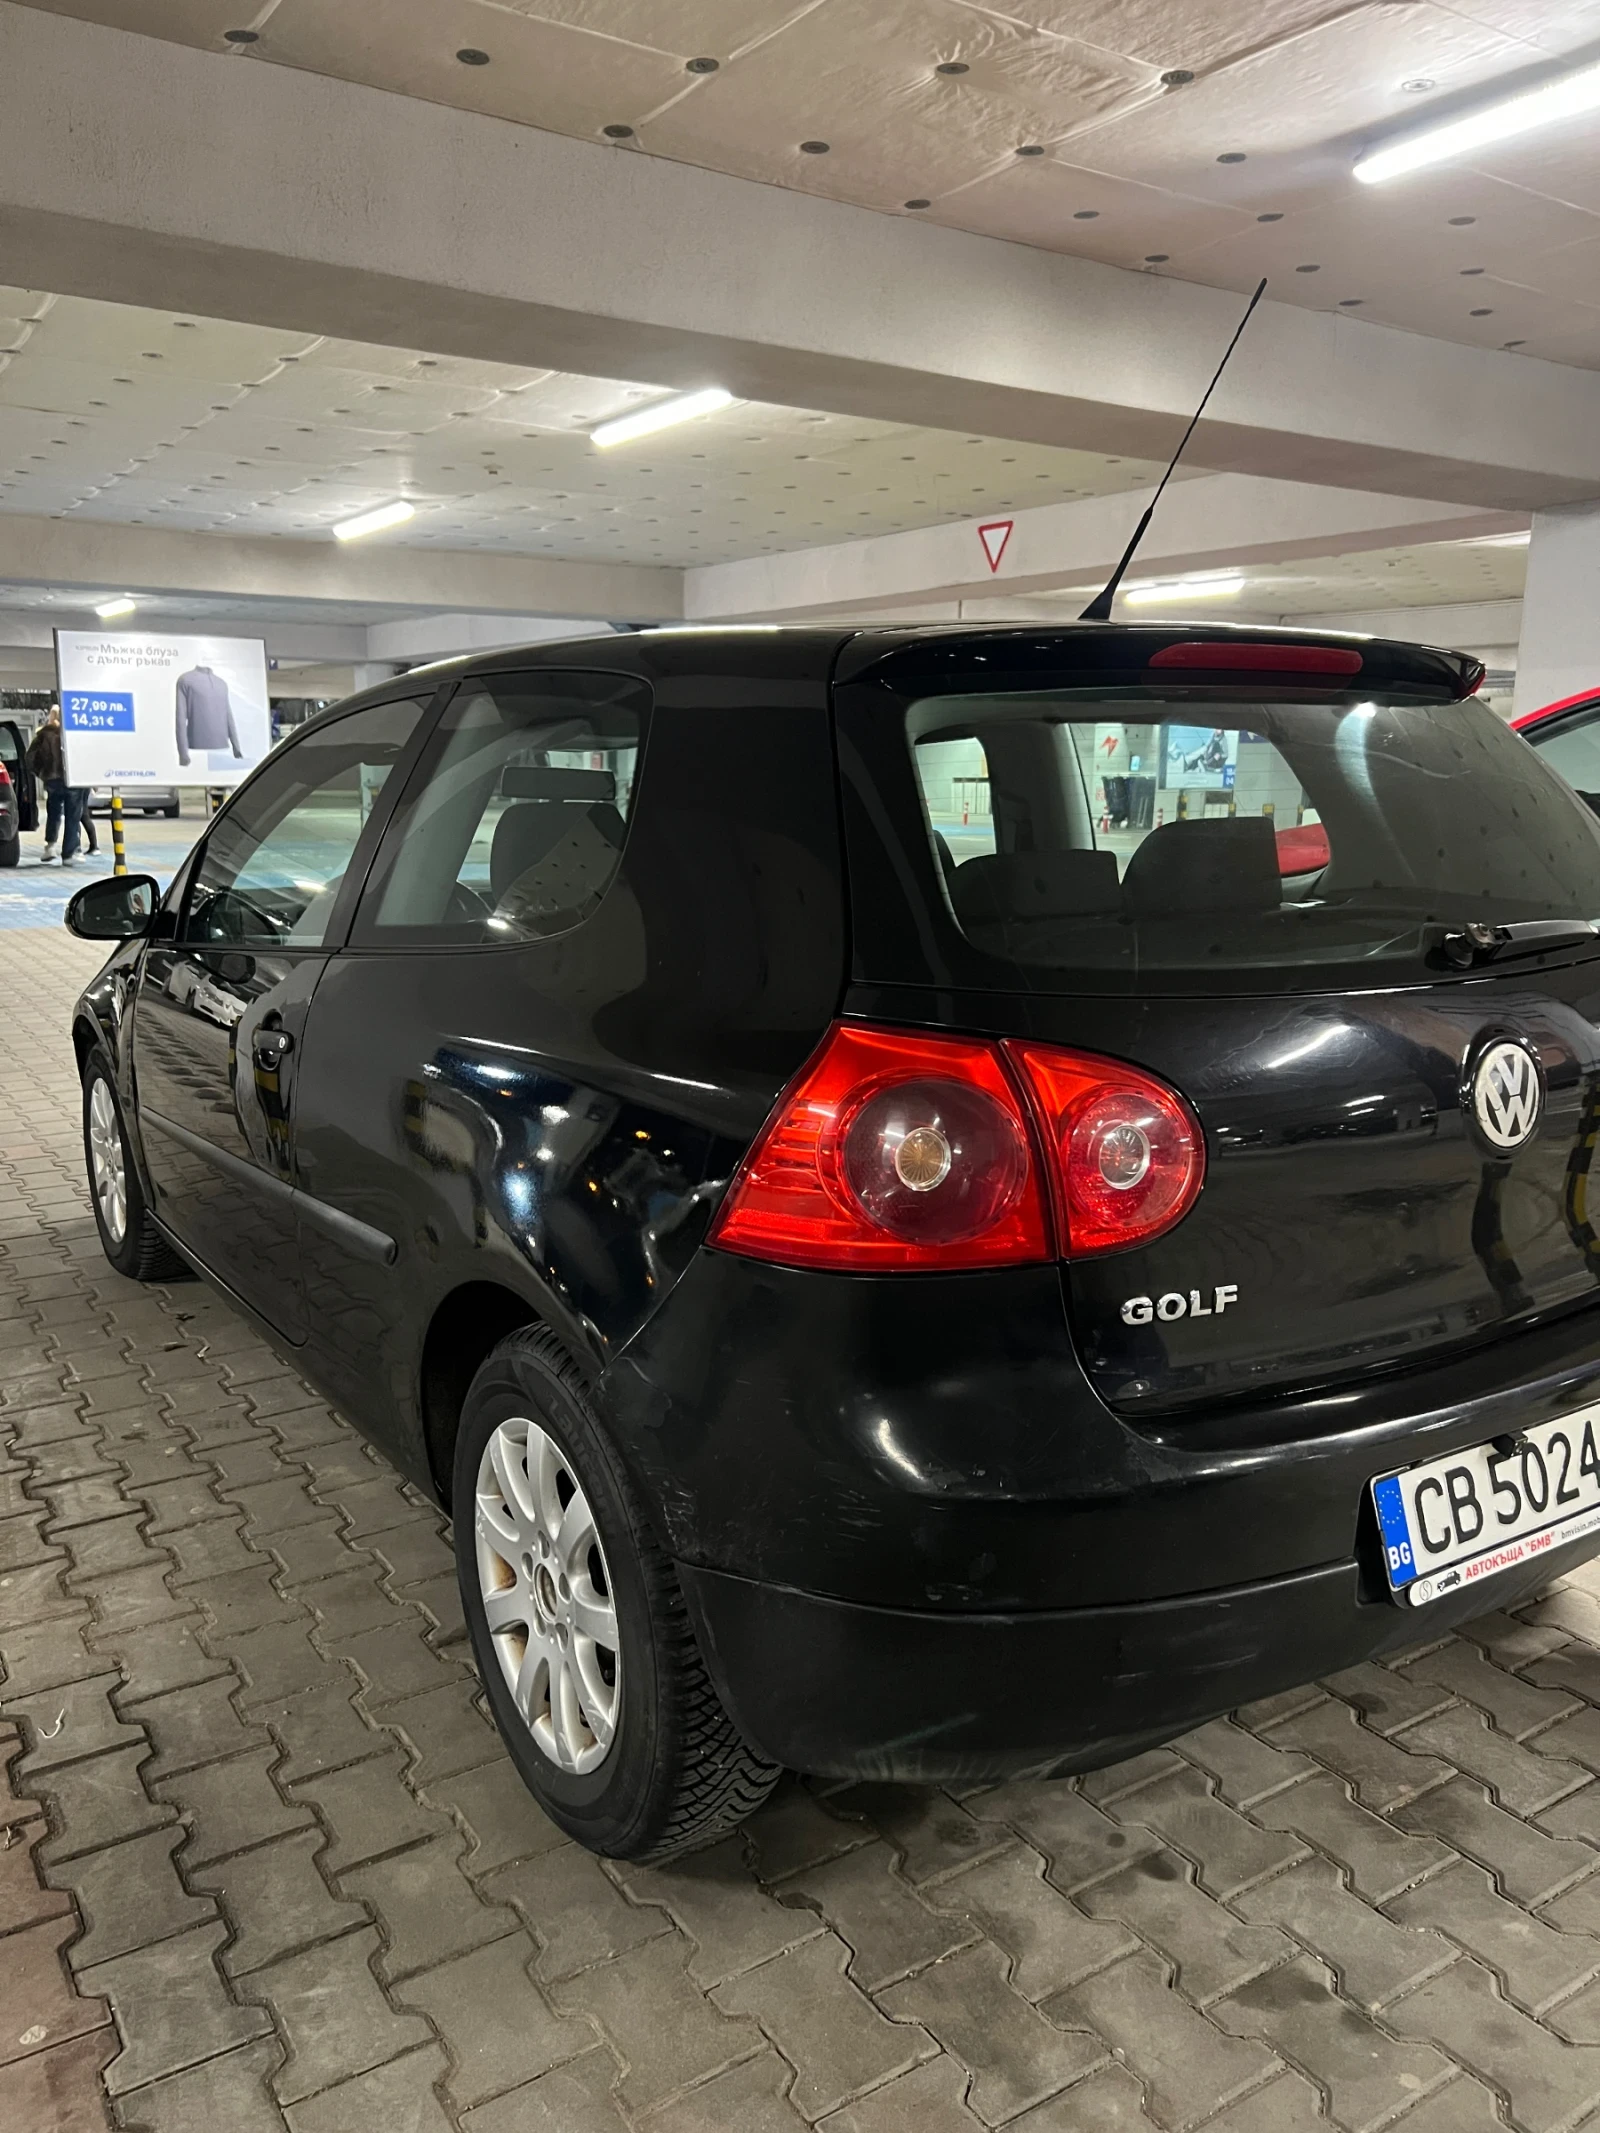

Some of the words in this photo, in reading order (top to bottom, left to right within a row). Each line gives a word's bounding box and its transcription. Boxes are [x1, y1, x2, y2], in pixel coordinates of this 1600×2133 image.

[97, 656, 133, 665] дълъг
[136, 657, 171, 667] ръкав
[100, 644, 143, 656] Мъжка
[146, 646, 179, 658] блуза
[71, 698, 108, 713] 27,99
[109, 702, 127, 712] лв.
[72, 713, 105, 727] 14,31
[107, 717, 115, 726] €
[1120, 1284, 1238, 1325] GOLF
[1415, 1466, 1483, 1554] CB
[1487, 1420, 1600, 1525] 5024
[1388, 1542, 1412, 1570] BG
[1465, 1544, 1524, 1580] АВТОКЪЩА
[1526, 1531, 1556, 1553] "БМВ"
